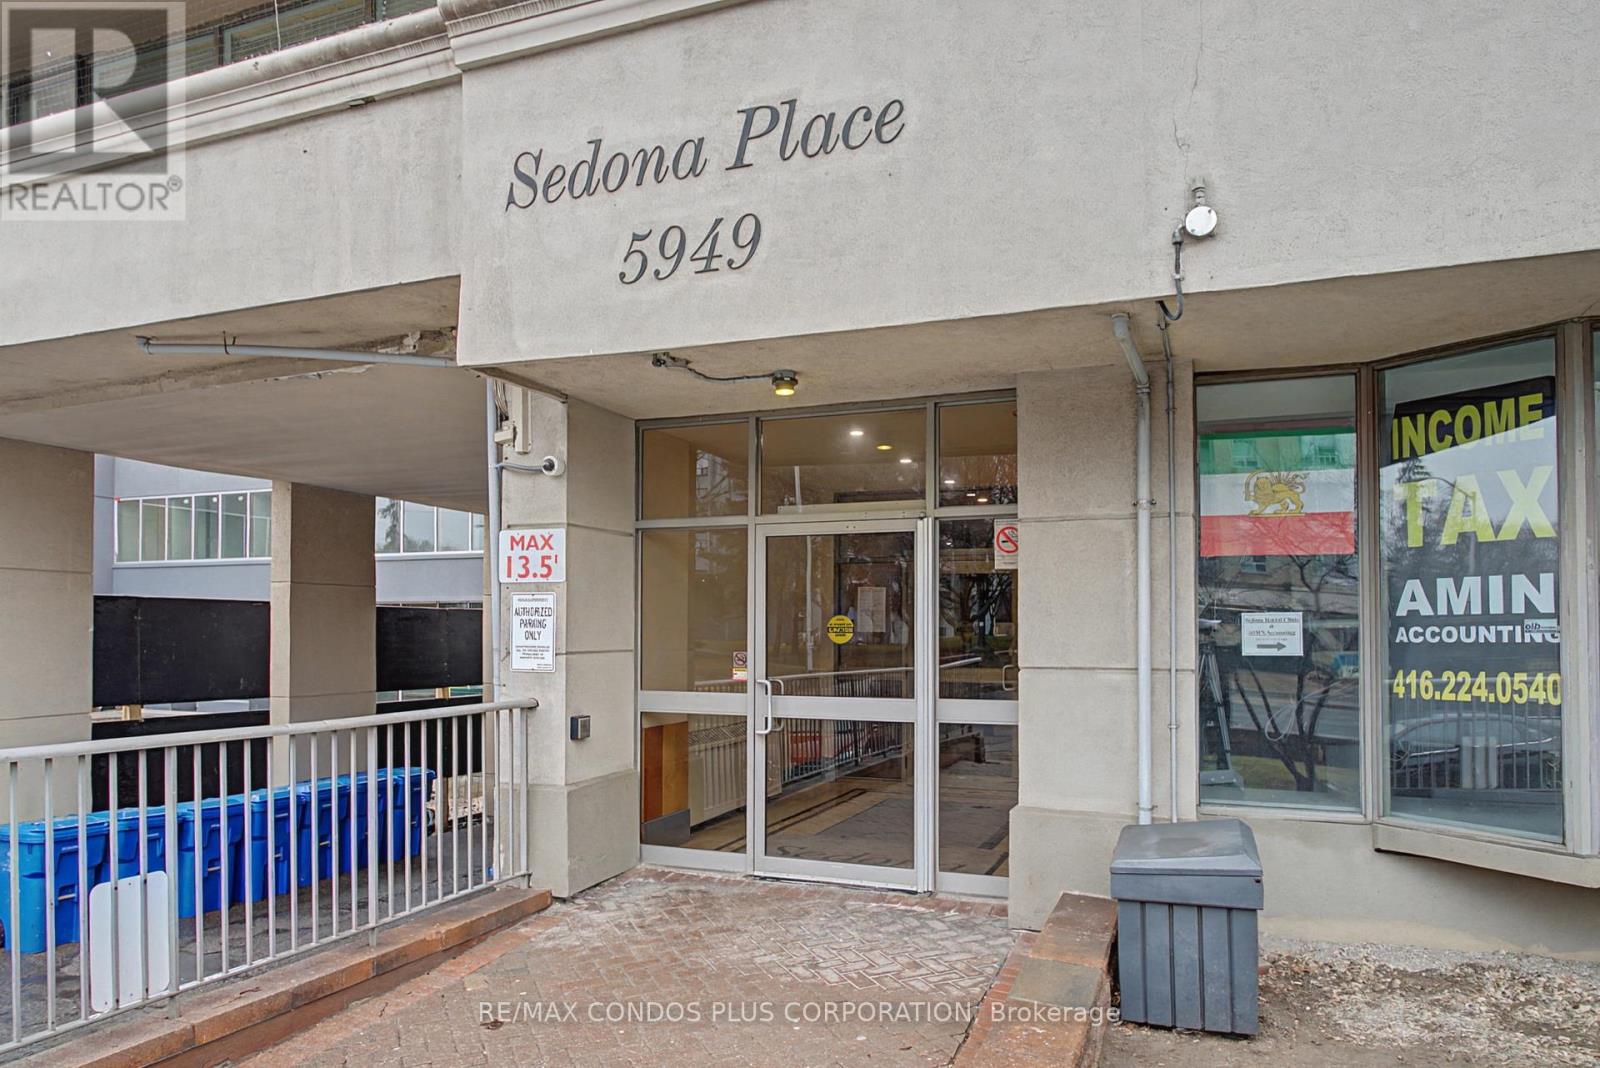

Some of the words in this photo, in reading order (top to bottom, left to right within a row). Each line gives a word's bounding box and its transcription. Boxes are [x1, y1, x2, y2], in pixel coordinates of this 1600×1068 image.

[505, 136, 707, 212] Sedona
[724, 98, 905, 171] Place
[618, 213, 762, 284] 5949
[1392, 393, 1544, 460] INCOME
[1393, 465, 1557, 548] TAX
[510, 534, 554, 551] MAX
[514, 606, 552, 617] AUTHORIZED
[1395, 573, 1555, 616] AMIN
[519, 619, 547, 629] PARKING
[524, 630, 542, 641] ONLY
[1393, 669, 1562, 705] 416.224.0540
